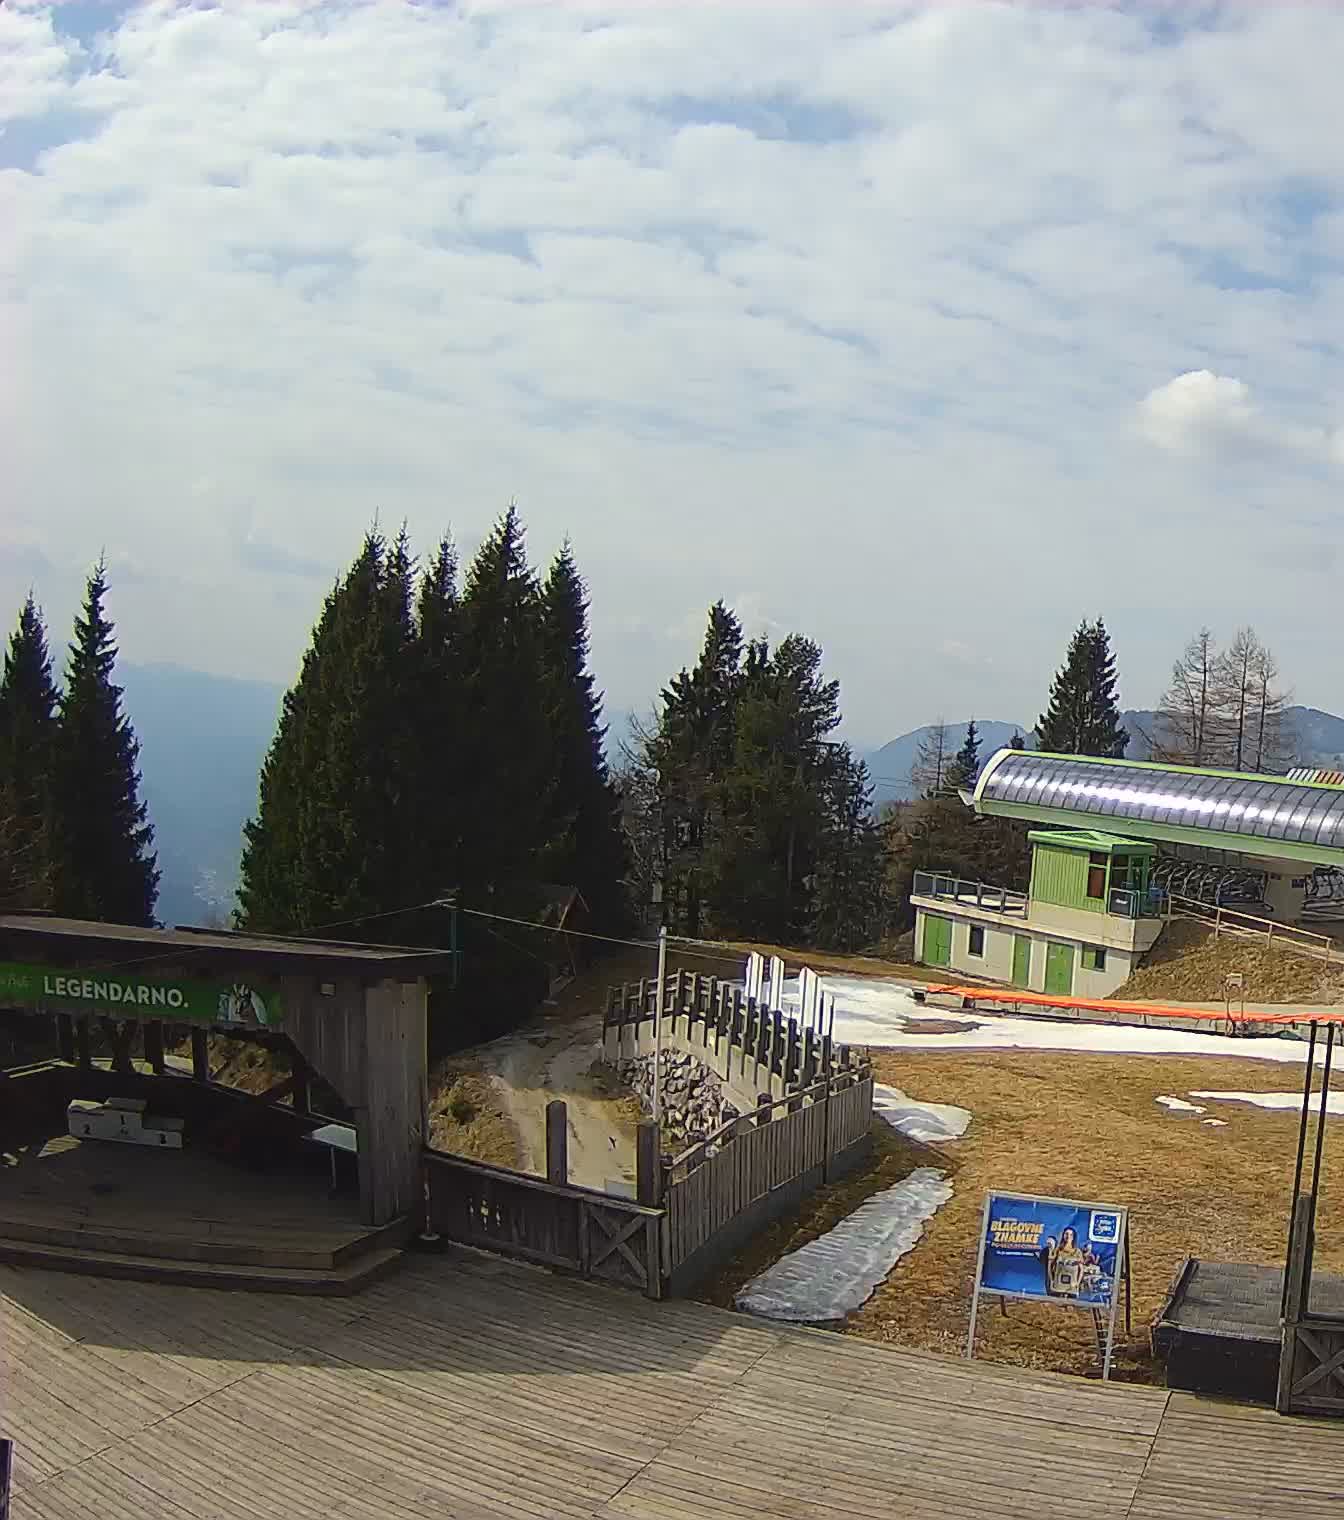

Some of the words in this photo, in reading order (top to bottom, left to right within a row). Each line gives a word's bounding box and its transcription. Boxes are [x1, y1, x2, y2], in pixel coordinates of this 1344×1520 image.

[43, 976, 190, 1009] LEGENDARNO.
[991, 1220, 1045, 1234] BLAGOVNE
[994, 1231, 1040, 1244] ZNAMKE
